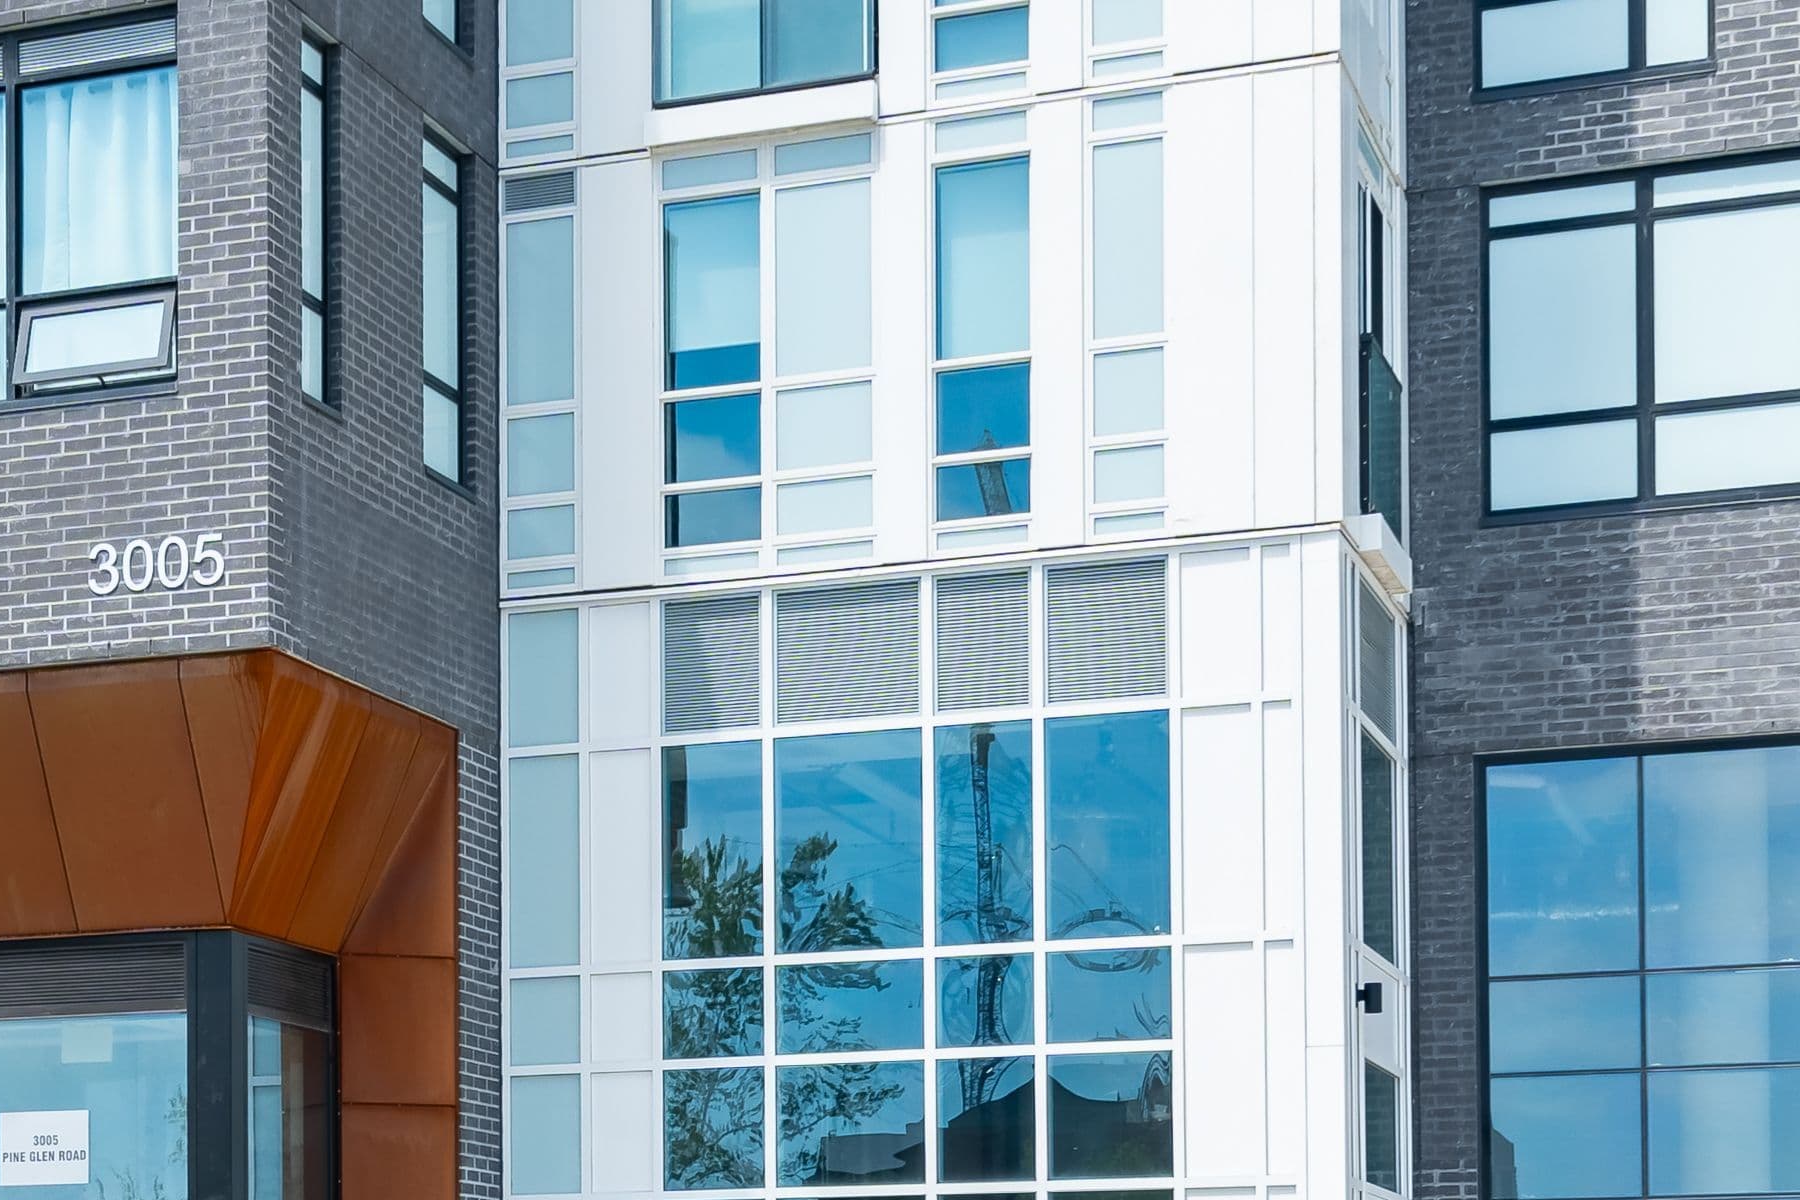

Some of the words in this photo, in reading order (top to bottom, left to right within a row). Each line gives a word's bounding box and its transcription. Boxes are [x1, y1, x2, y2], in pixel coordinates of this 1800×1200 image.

[87, 532, 225, 596] 3005
[32, 1134, 59, 1146] 3005
[2, 1151, 26, 1163] PINE
[29, 1150, 55, 1162] GLEN
[58, 1149, 87, 1161] ROAD
